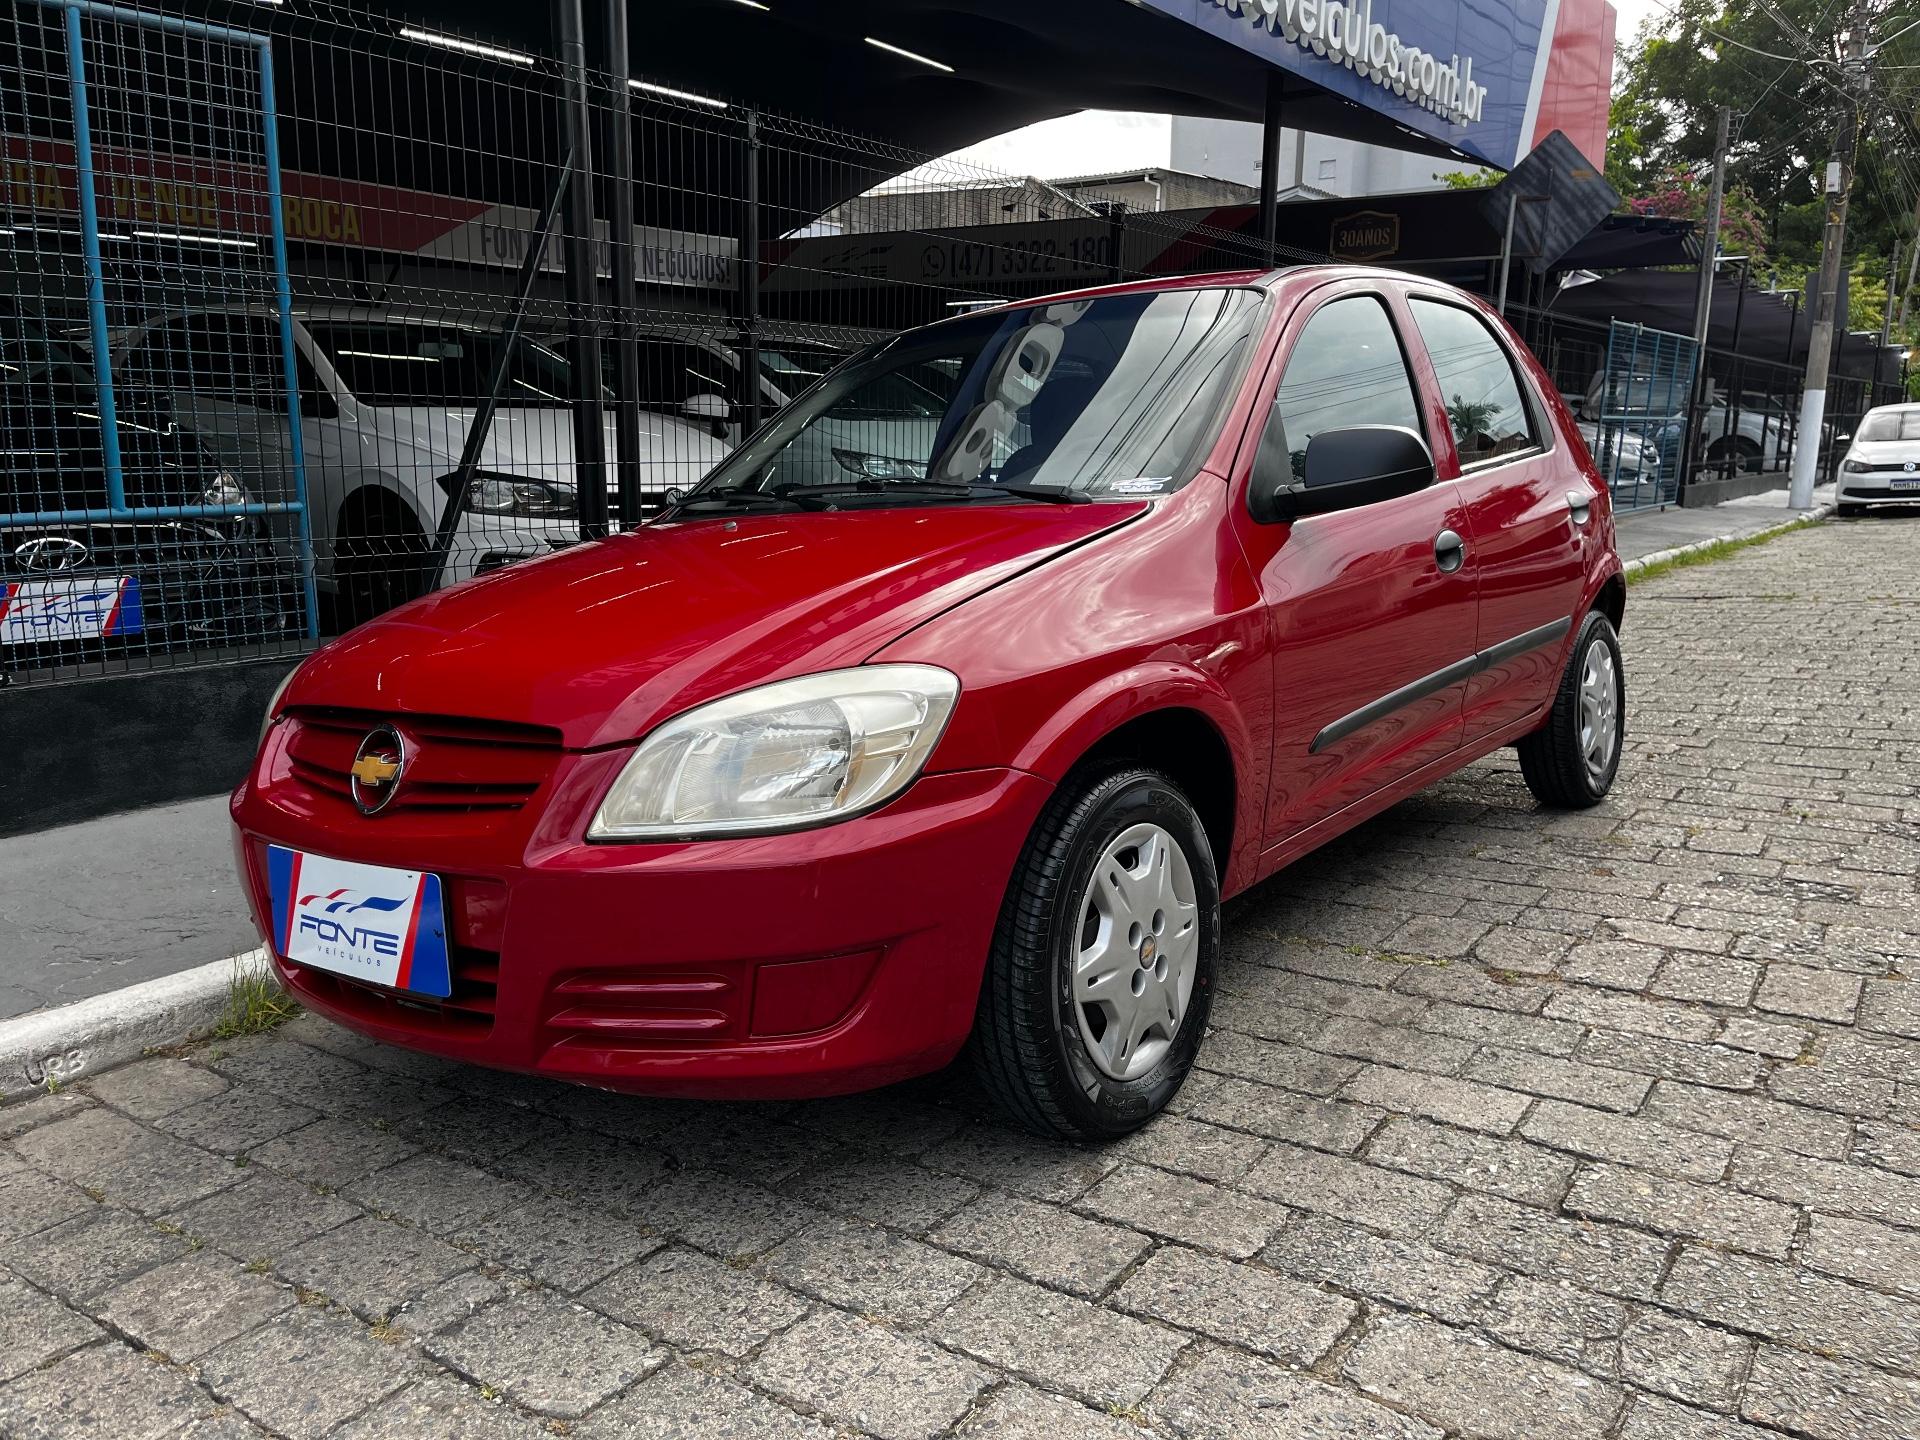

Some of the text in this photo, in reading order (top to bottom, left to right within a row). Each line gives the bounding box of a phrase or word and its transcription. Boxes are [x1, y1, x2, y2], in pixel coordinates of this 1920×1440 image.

[113, 175, 218, 226] VENDE
[281, 196, 361, 243] ROCA
[951, 235, 1124, 277] (47) 3322-180
[299, 913, 399, 956] FONTE
